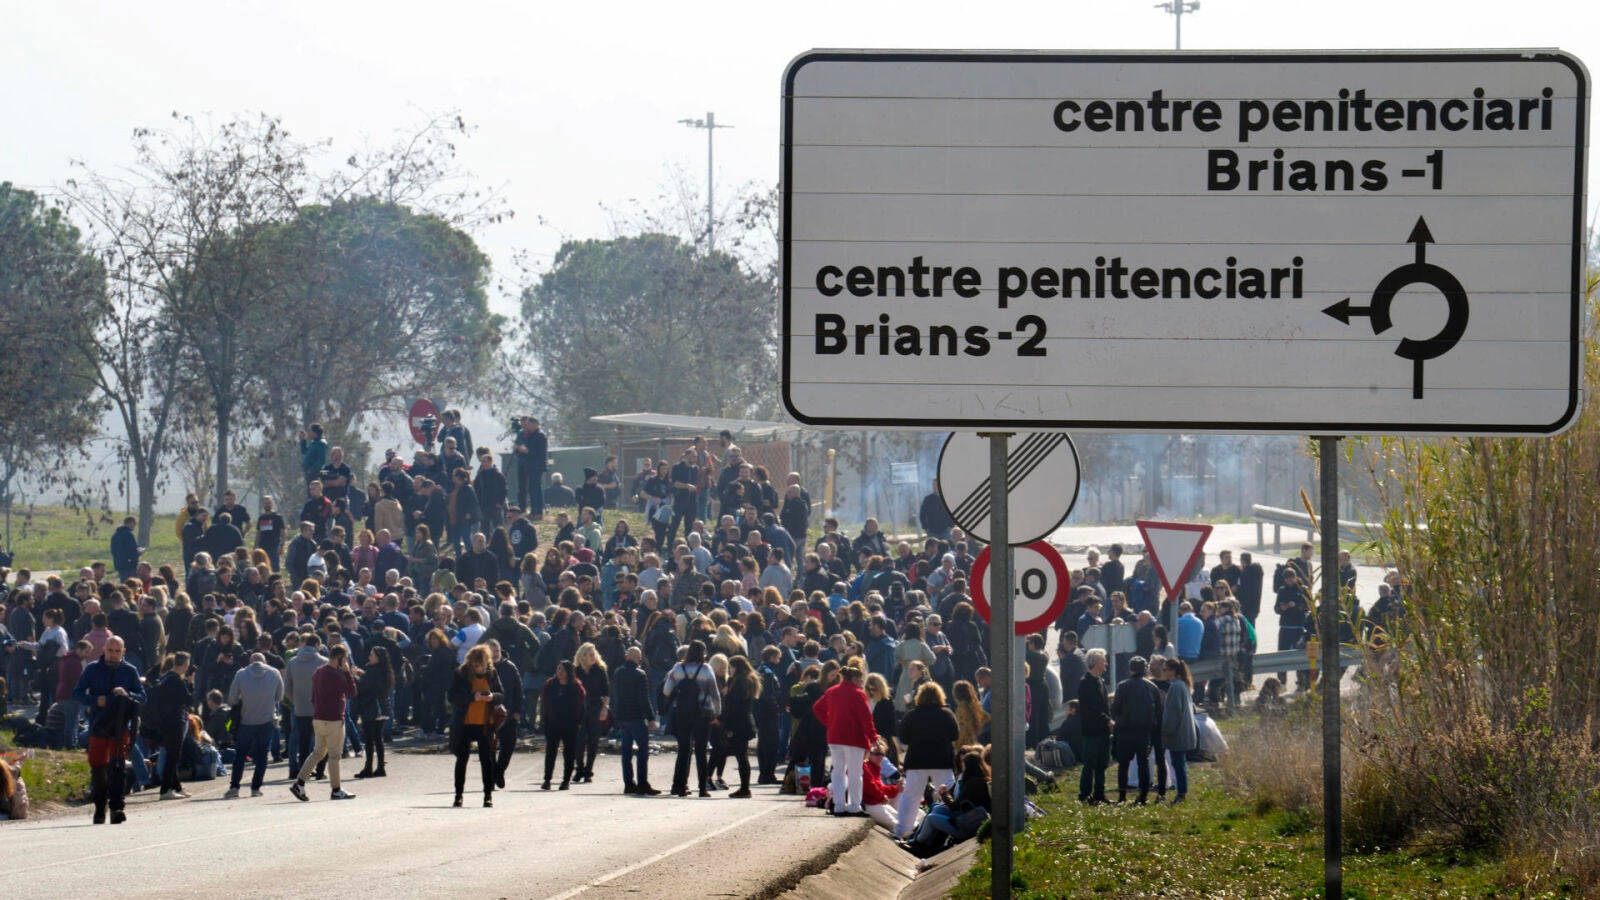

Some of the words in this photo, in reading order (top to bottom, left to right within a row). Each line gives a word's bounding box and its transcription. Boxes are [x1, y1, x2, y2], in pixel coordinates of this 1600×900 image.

[1053, 90, 1223, 133] centre
[1238, 87, 1554, 143] penitenciari
[1207, 147, 1389, 192] Brians
[815, 256, 982, 299] centre
[997, 255, 1304, 309] penitenciari
[814, 312, 1048, 357] Brians-2
